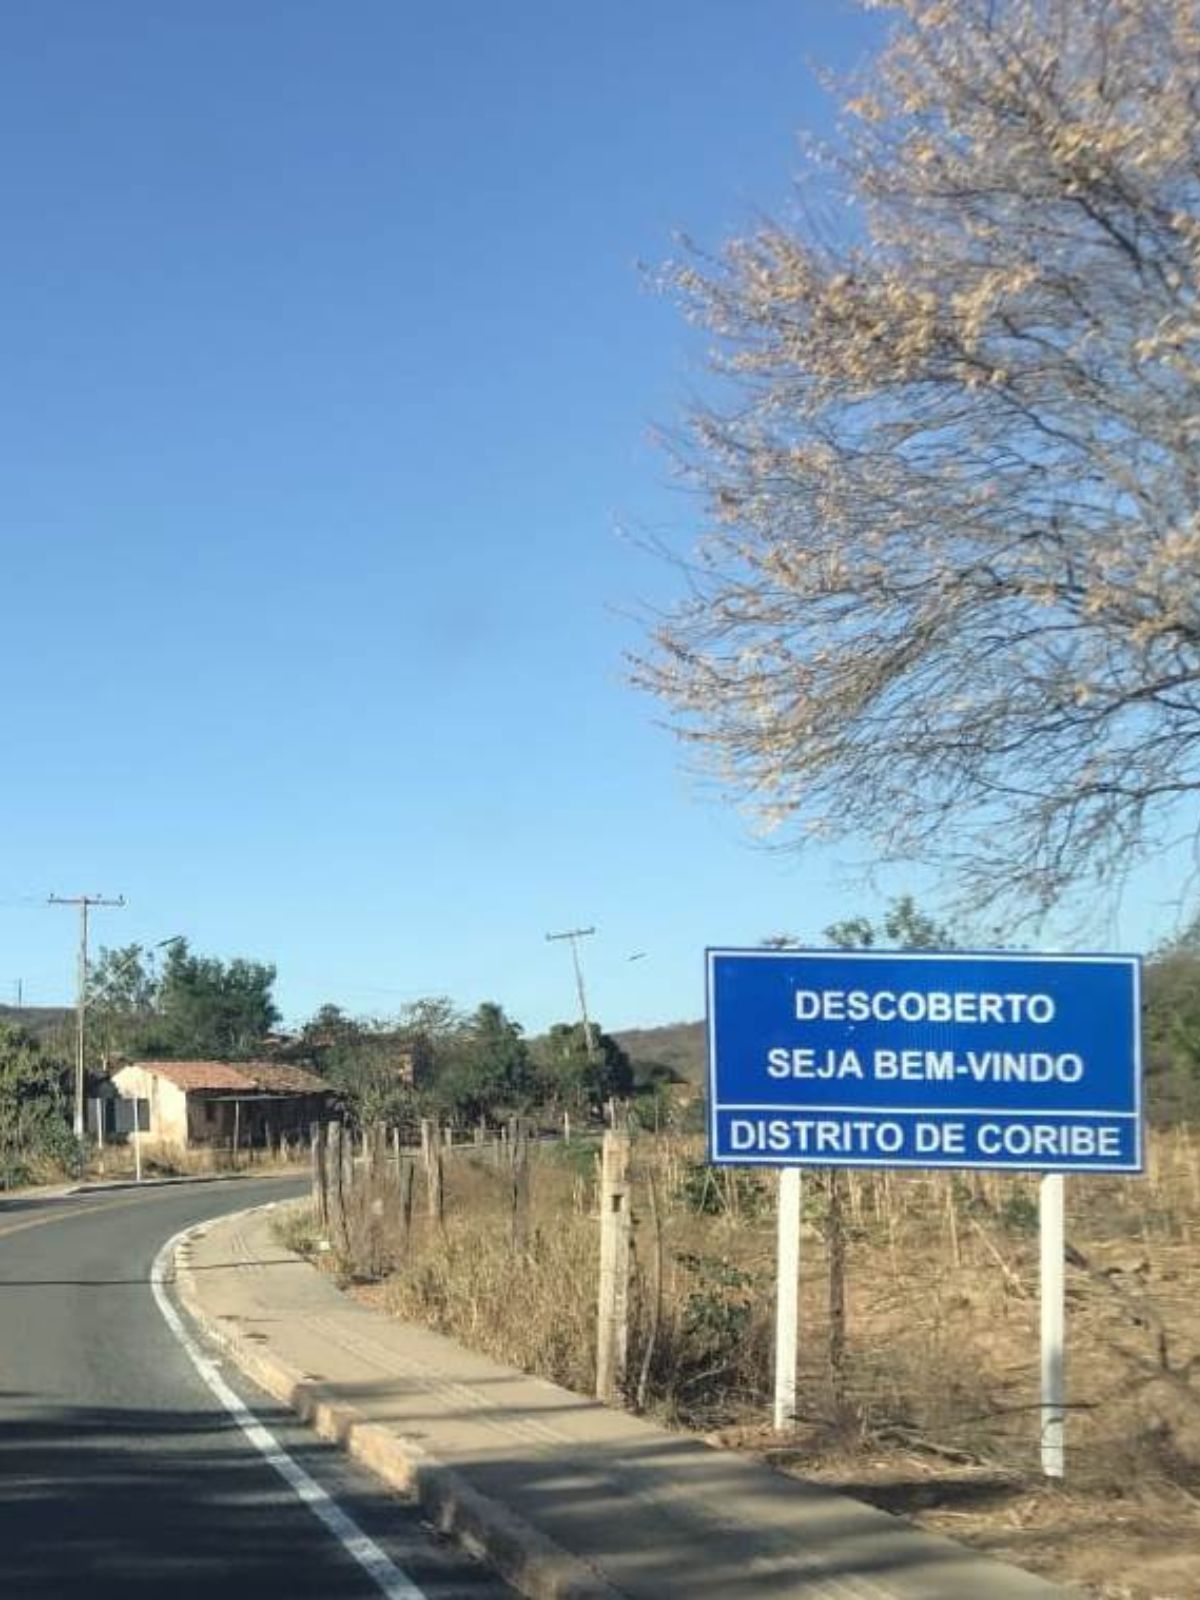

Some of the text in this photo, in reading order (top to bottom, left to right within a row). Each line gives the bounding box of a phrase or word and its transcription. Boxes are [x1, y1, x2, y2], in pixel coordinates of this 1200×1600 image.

[795, 990, 1056, 1024] DESCOBERTO
[767, 1048, 1083, 1082] SEJA BEM-VINDO
[730, 1120, 1121, 1156] DISTRITO DE CORIBE
